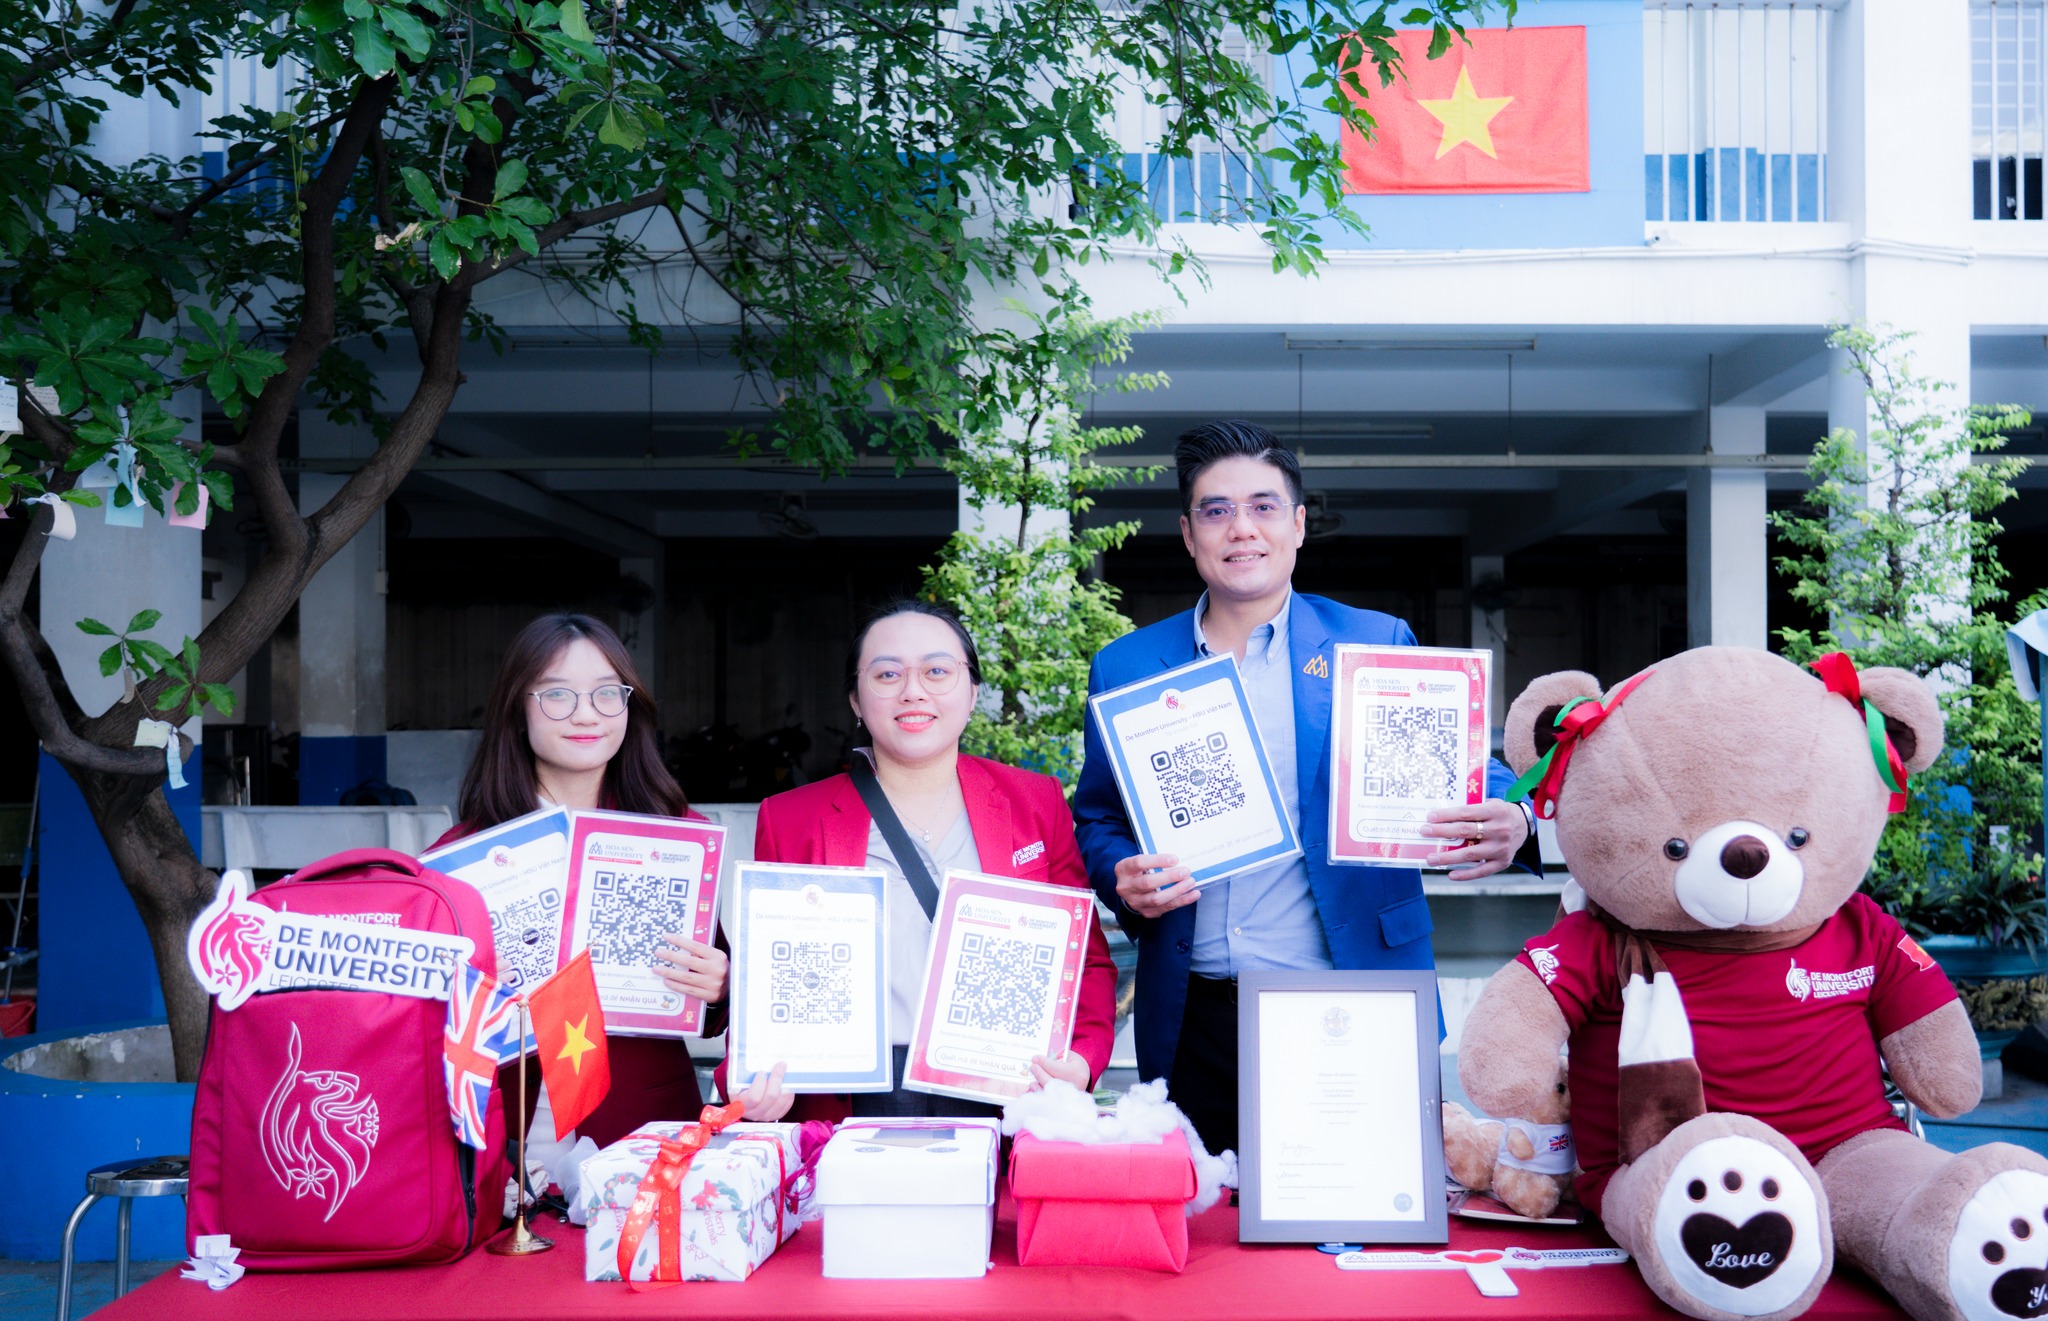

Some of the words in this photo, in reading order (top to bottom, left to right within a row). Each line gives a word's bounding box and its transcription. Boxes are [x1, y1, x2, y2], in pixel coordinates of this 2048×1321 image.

[1134, 726, 1159, 739] Montfort
[1160, 716, 1188, 730] University
[1192, 710, 1206, 719] HSU
[1218, 701, 1232, 710] Nam
[604, 850, 643, 859] UNIVERSITY
[488, 874, 519, 888] University
[523, 867, 537, 875] HSU
[551, 856, 566, 864] Nam
[974, 913, 1011, 924] UNIVERSITY
[523, 932, 538, 942] Zalo
[278, 925, 313, 946] DE
[320, 930, 463, 966] MONTFORT
[274, 947, 454, 992] UNIVERSITY
[1810, 972, 1821, 980] DE
[1822, 966, 1874, 981] MONTFORT
[1812, 975, 1875, 991] UNIVERSITY
[1814, 990, 1849, 998] LEICESTER
[1705, 1242, 1774, 1268] Love
